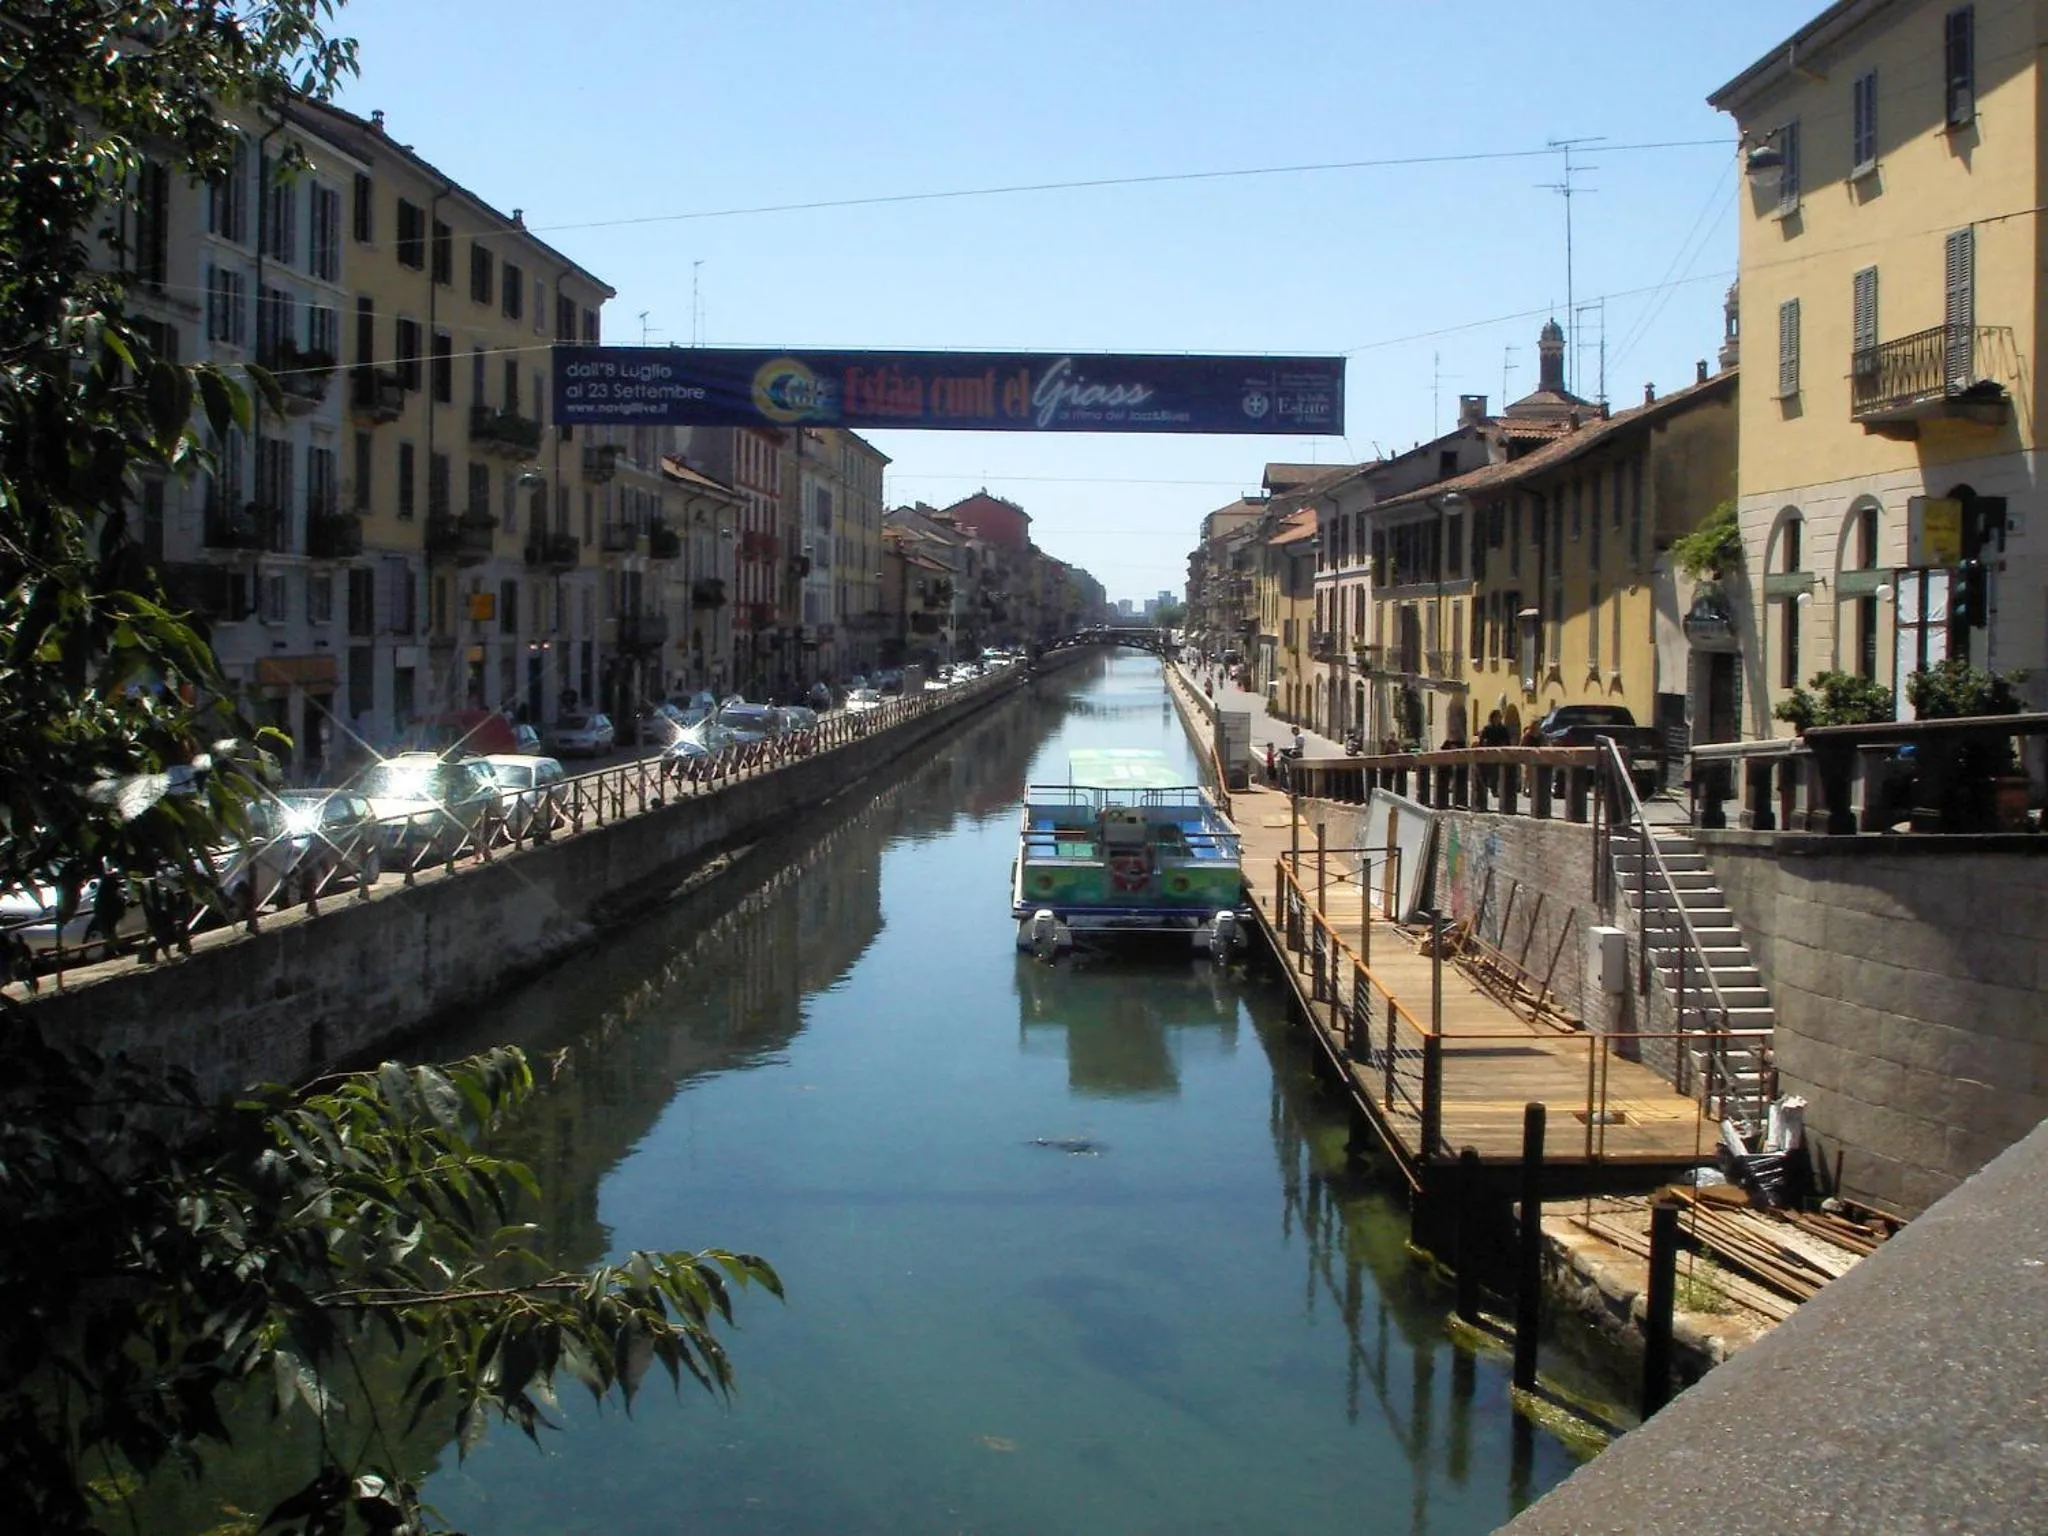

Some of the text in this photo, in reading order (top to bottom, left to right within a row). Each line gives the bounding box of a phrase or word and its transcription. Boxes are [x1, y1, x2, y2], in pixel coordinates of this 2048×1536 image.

[621, 362, 673, 382] Luglio
[566, 383, 706, 400] al 23 Settembre
